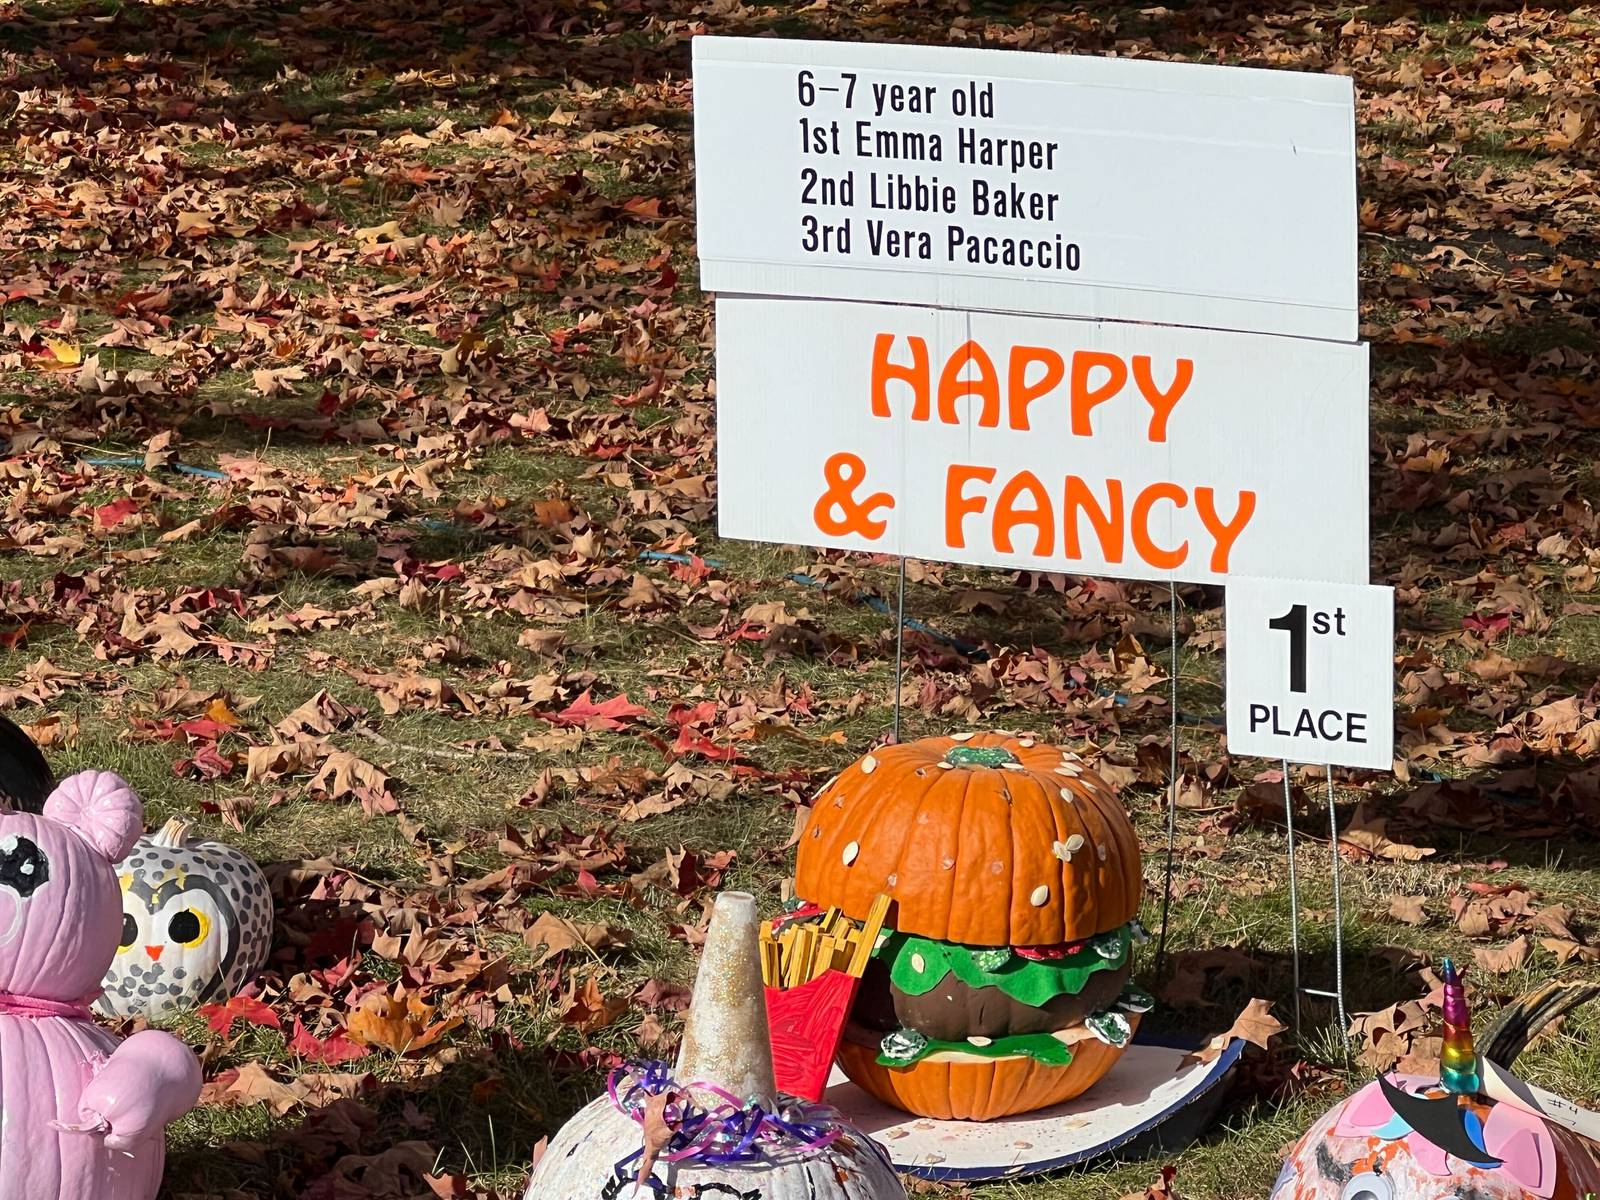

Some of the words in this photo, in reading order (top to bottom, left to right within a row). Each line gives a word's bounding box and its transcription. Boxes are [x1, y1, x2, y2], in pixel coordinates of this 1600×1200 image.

[872, 83, 937, 117] year
[952, 80, 994, 119] old
[799, 117, 840, 155] 1st
[855, 120, 942, 162] Emma
[958, 127, 1058, 174] Harper
[801, 167, 854, 207] 2nd
[870, 172, 956, 214] Libbie
[972, 179, 1059, 222] Baker
[801, 215, 851, 254] 3rd
[866, 219, 932, 260] Vera
[947, 225, 1080, 271] Pacaccio
[871, 333, 1194, 443] HAPPY
[813, 452, 896, 541] &
[945, 463, 1256, 574] FANCY
[1268, 604, 1346, 694] 1st
[1249, 703, 1367, 744] PLACE
